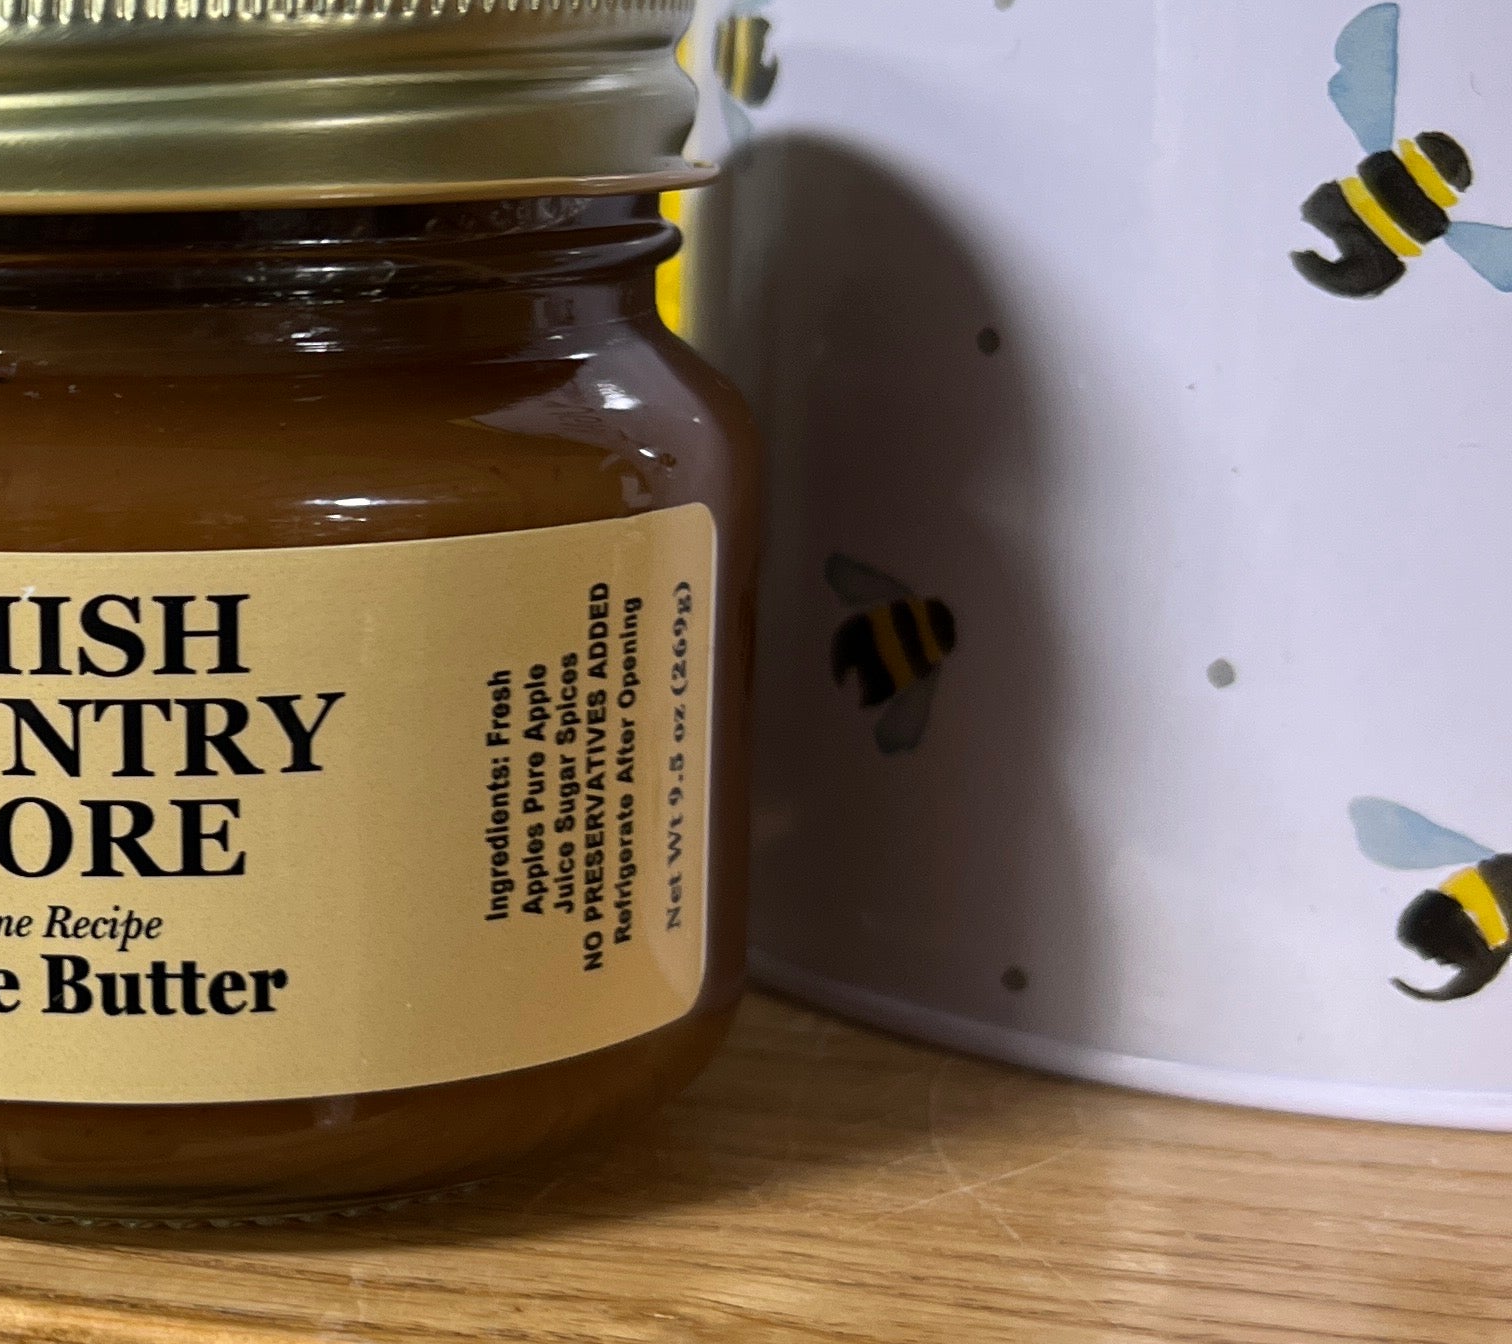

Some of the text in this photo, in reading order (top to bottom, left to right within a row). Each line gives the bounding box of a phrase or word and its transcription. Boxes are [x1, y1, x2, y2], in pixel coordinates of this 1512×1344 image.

[484, 669, 516, 922] Ingredients: Fresh
[521, 662, 552, 916] Apples Pure Apple
[553, 651, 582, 915] Juice Sugar Spices
[583, 582, 609, 972] NO PRESERVATIVES ADDED
[613, 596, 644, 945] Refrigerate After Opening
[666, 580, 693, 932] Net Wt 9.5 oz (269g)
[40, 953, 290, 1017] Butter
[41, 904, 164, 952] Recipe
